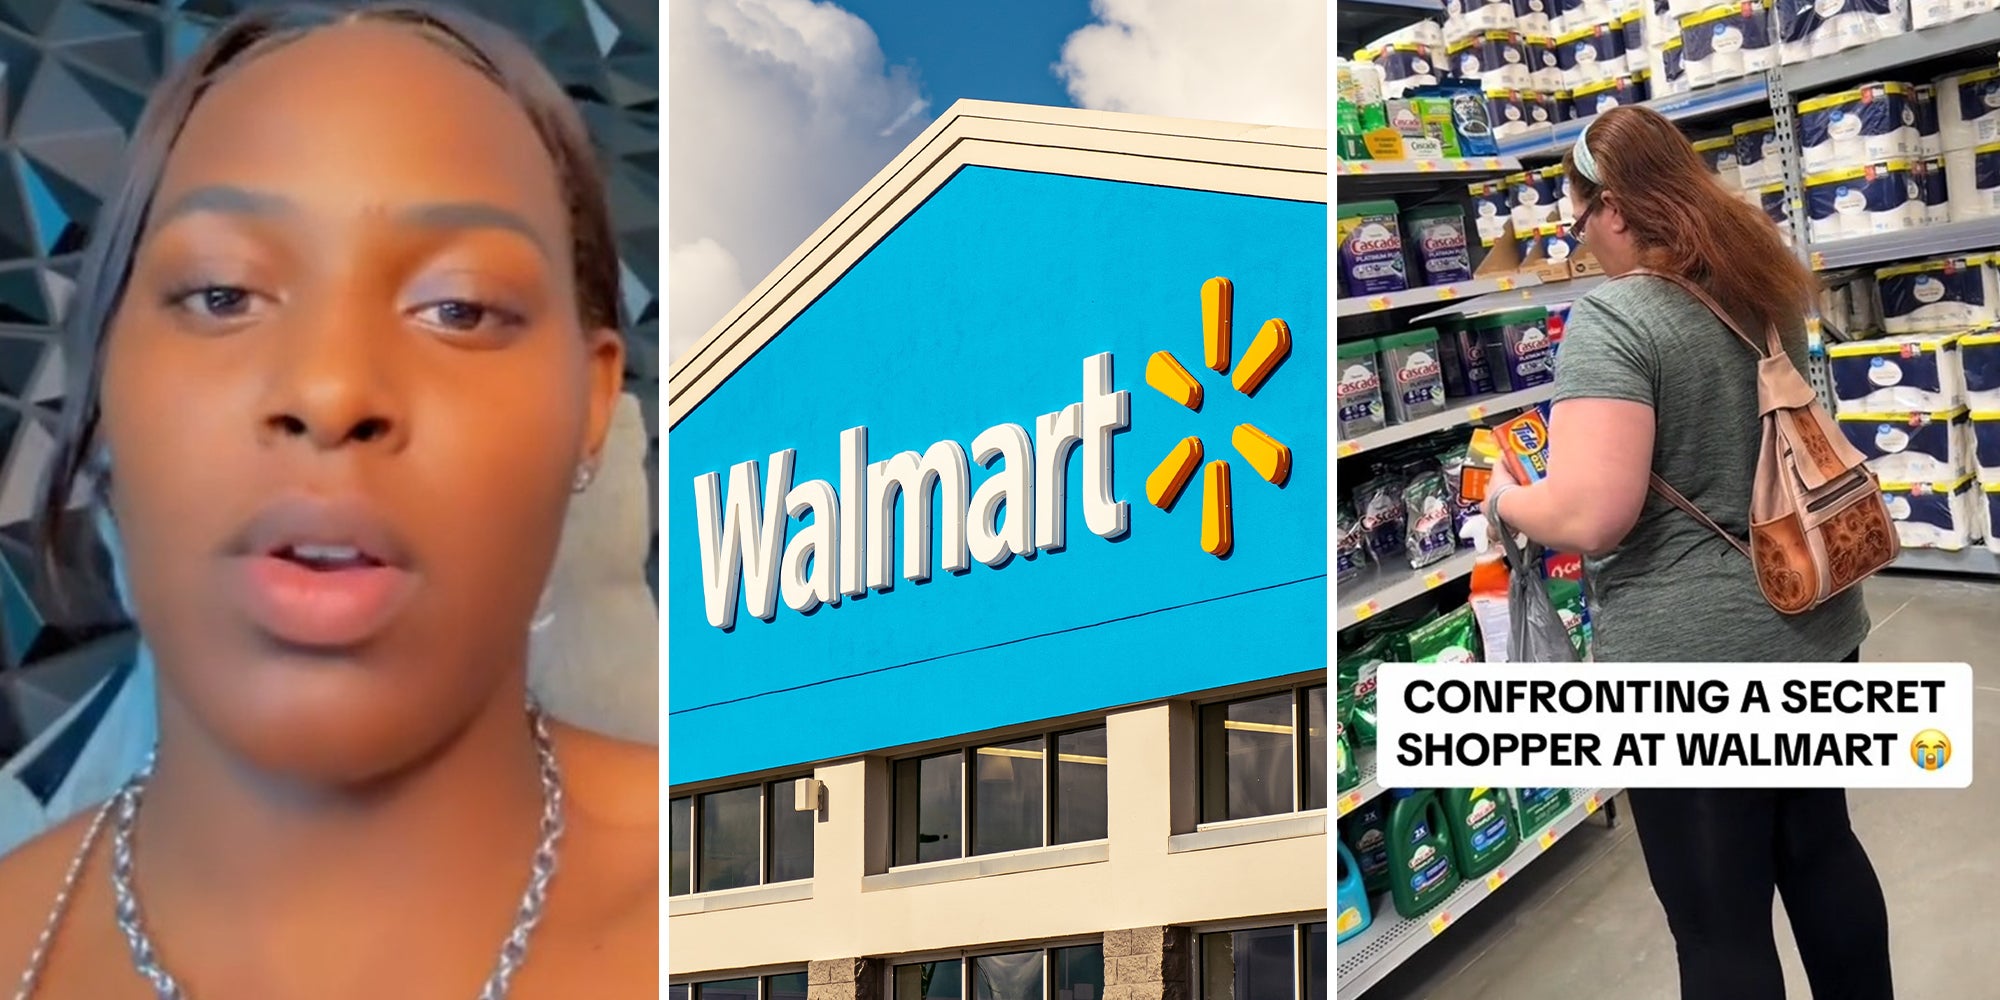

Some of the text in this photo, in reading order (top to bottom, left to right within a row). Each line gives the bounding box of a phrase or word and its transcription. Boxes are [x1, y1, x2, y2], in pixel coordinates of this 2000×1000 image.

[1411, 138, 1438, 151] Cascade
[1351, 235, 1400, 255] Cascade
[1511, 421, 1539, 450] Tide
[693, 351, 1130, 630] Walmart
[1414, 825, 1426, 838] 2X
